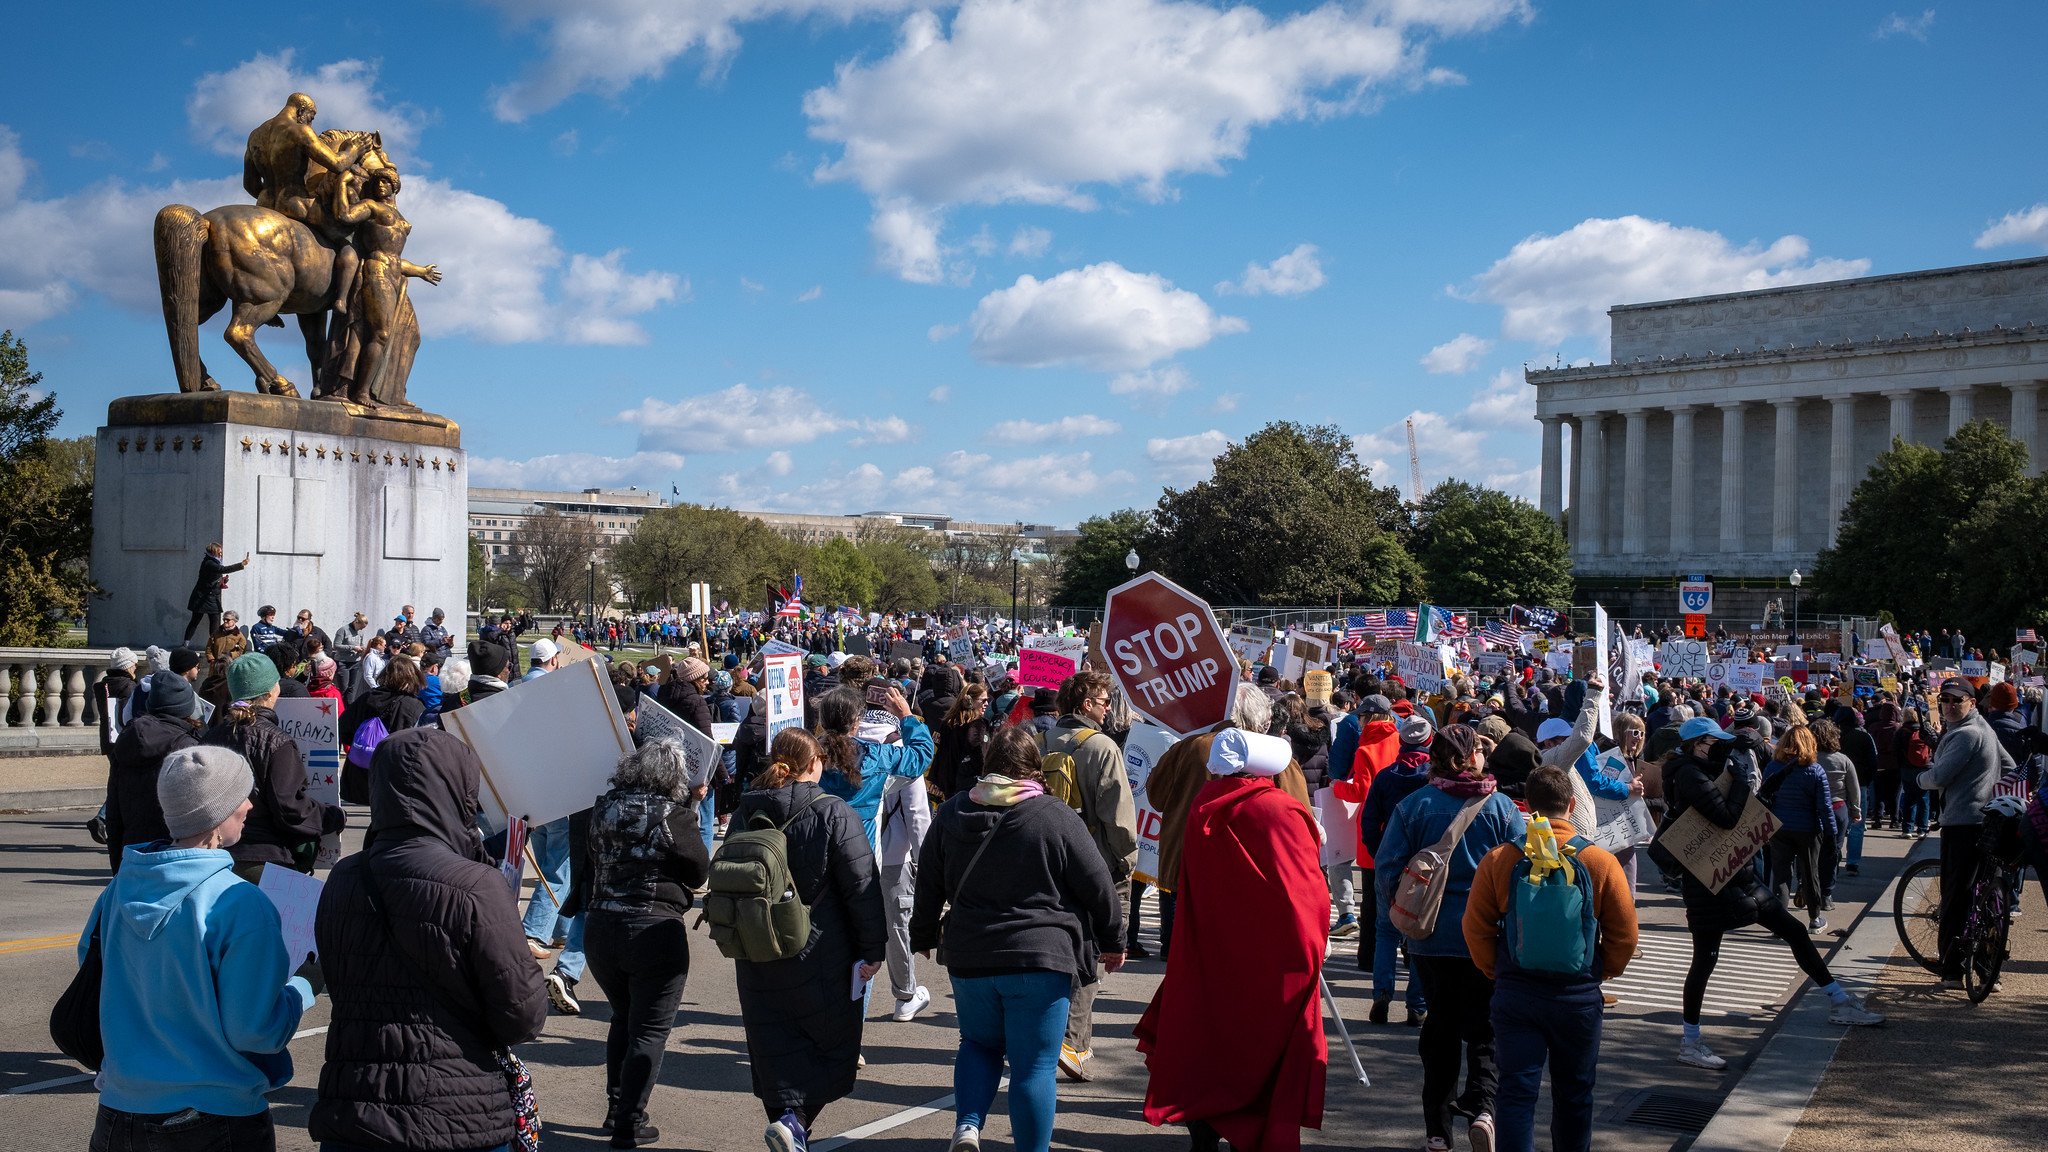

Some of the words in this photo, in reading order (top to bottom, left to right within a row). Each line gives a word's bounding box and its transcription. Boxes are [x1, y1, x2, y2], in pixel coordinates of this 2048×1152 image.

[1688, 593, 1705, 606] 66
[946, 626, 964, 640] MELT
[952, 639, 970, 654] ICE
[1035, 639, 1064, 648] REGIME
[1054, 643, 1082, 653] CHANGE
[1114, 612, 1202, 676] STOP
[1668, 642, 1702, 654] NO
[1400, 642, 1419, 658] PROUD
[1420, 650, 1428, 659] TO
[1430, 652, 1438, 662] BE
[1734, 648, 1747, 658] ICE
[1022, 652, 1073, 672] DEMOCRACY
[1399, 660, 1407, 670] AN
[1407, 659, 1438, 676] AMERICAN
[1662, 654, 1706, 666] MORE
[1661, 664, 1705, 676] WAR
[1962, 667, 1984, 676] DEPORT
[768, 667, 785, 690] DEFEND
[789, 678, 800, 689] STOP
[1023, 673, 1060, 686] COURAG
[1136, 658, 1219, 708] TRUMP
[1416, 673, 1439, 694] FASCISM
[1764, 686, 1780, 695] 1776
[773, 694, 782, 715] THE
[282, 720, 334, 743] IGRANTS
[1128, 755, 1141, 766] SAID
[1596, 814, 1620, 847] NICE
[1681, 821, 1718, 859] ABSURDIT
[1708, 822, 1752, 866] ATROCITIES
[1708, 841, 1754, 890] Wake
[1747, 812, 1775, 847] Up!
